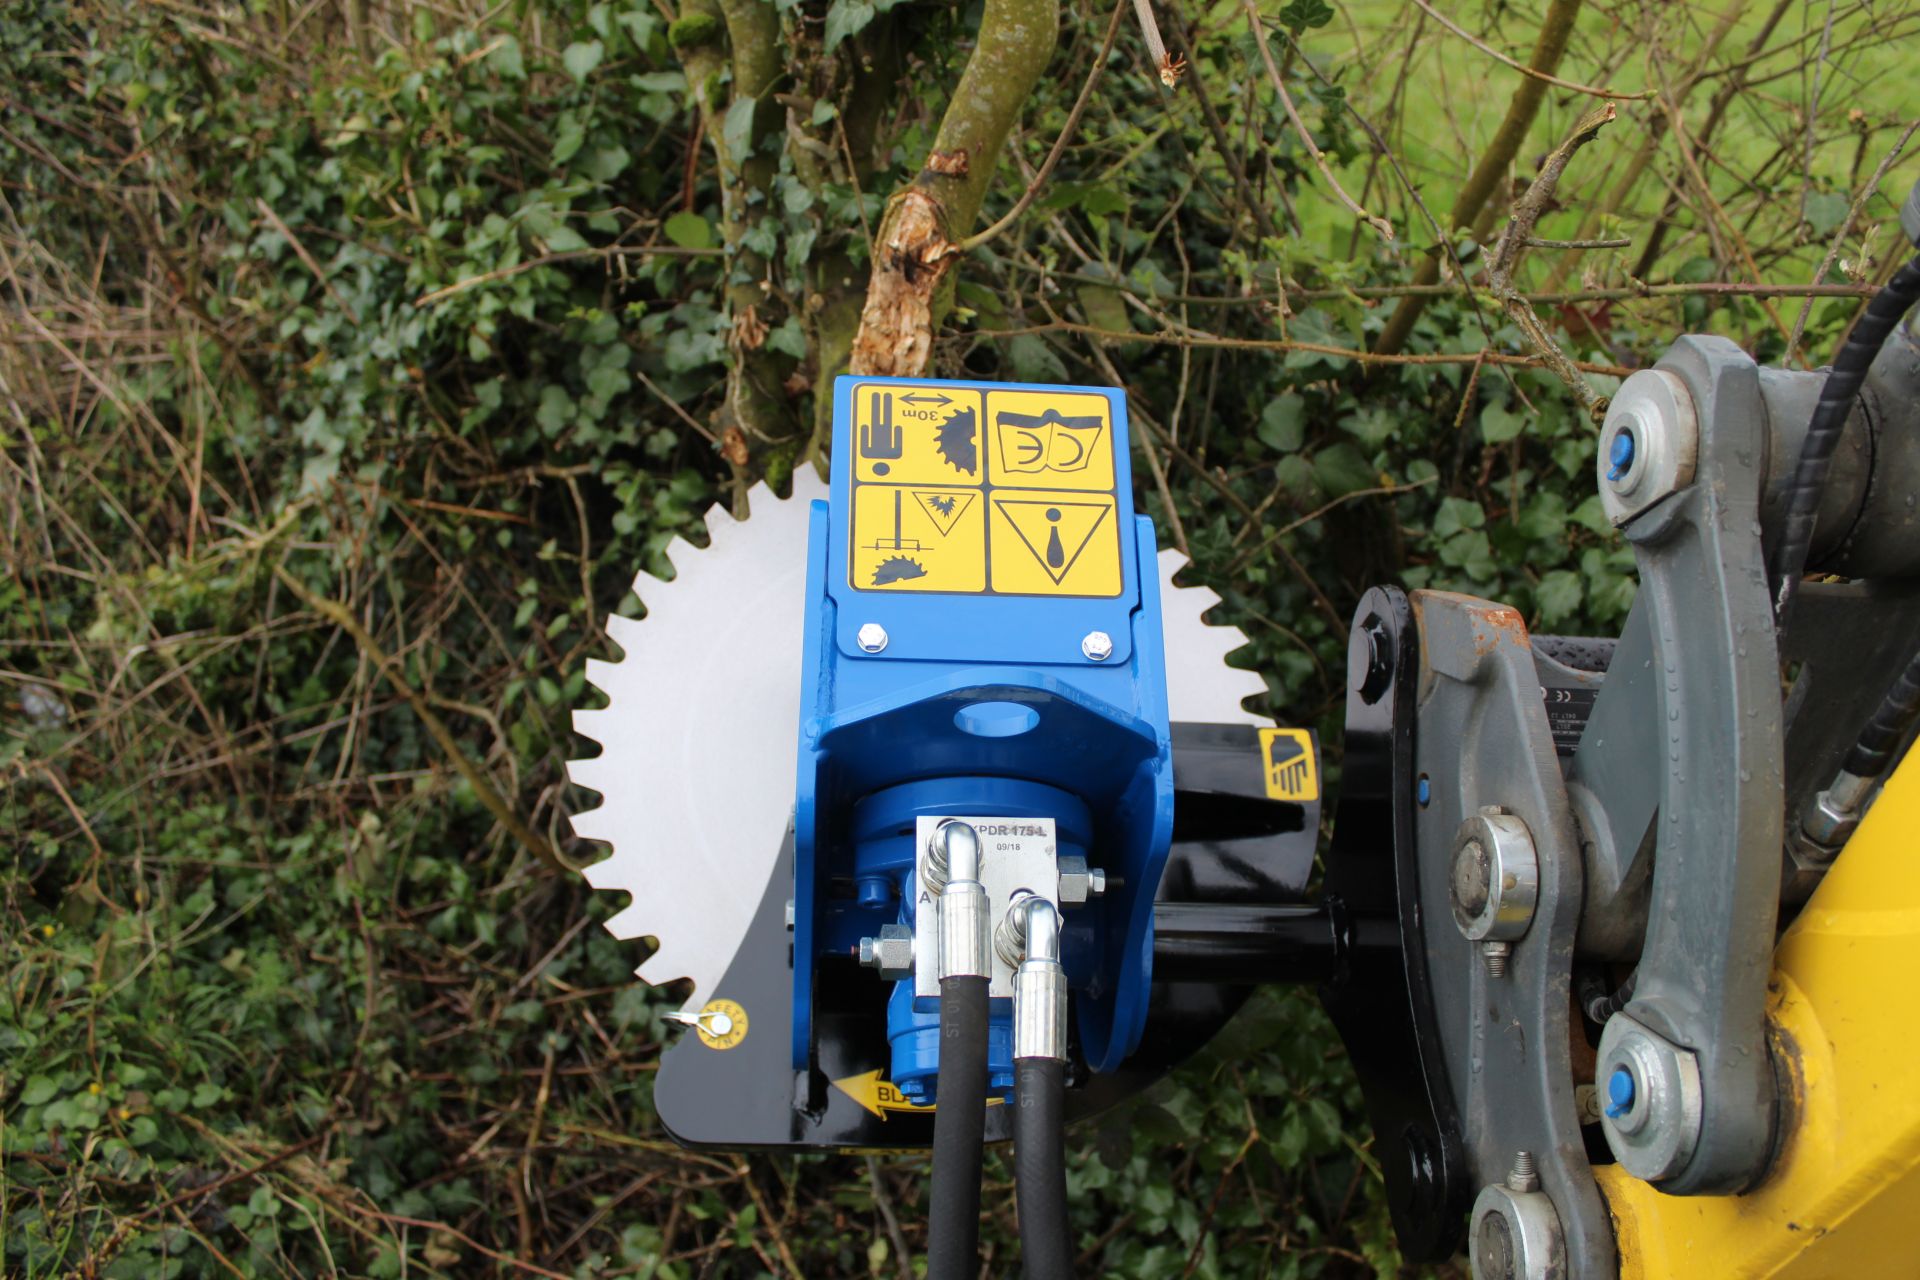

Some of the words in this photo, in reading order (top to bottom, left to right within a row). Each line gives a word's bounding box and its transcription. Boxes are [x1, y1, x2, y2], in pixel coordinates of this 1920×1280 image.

[902, 410, 938, 421] 30m
[1556, 690, 1571, 702] CE
[974, 825, 1008, 836] PDR
[996, 842, 1021, 851] 09/18
[919, 891, 931, 904] A
